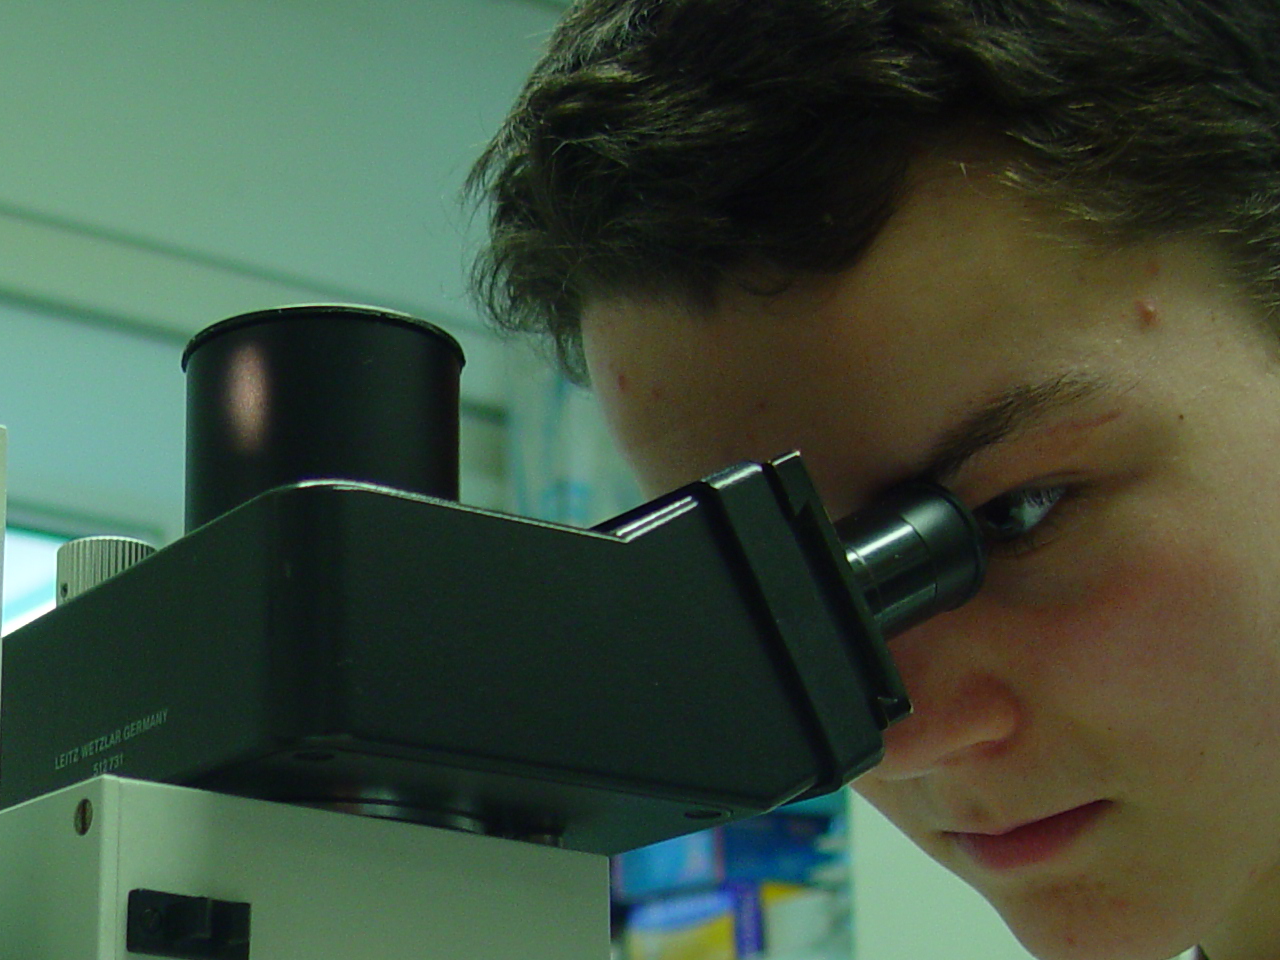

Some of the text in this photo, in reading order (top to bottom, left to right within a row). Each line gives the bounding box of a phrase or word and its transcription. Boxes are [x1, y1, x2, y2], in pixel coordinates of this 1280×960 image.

[54, 708, 169, 770] LEITZ WETZLAR GERMANY
